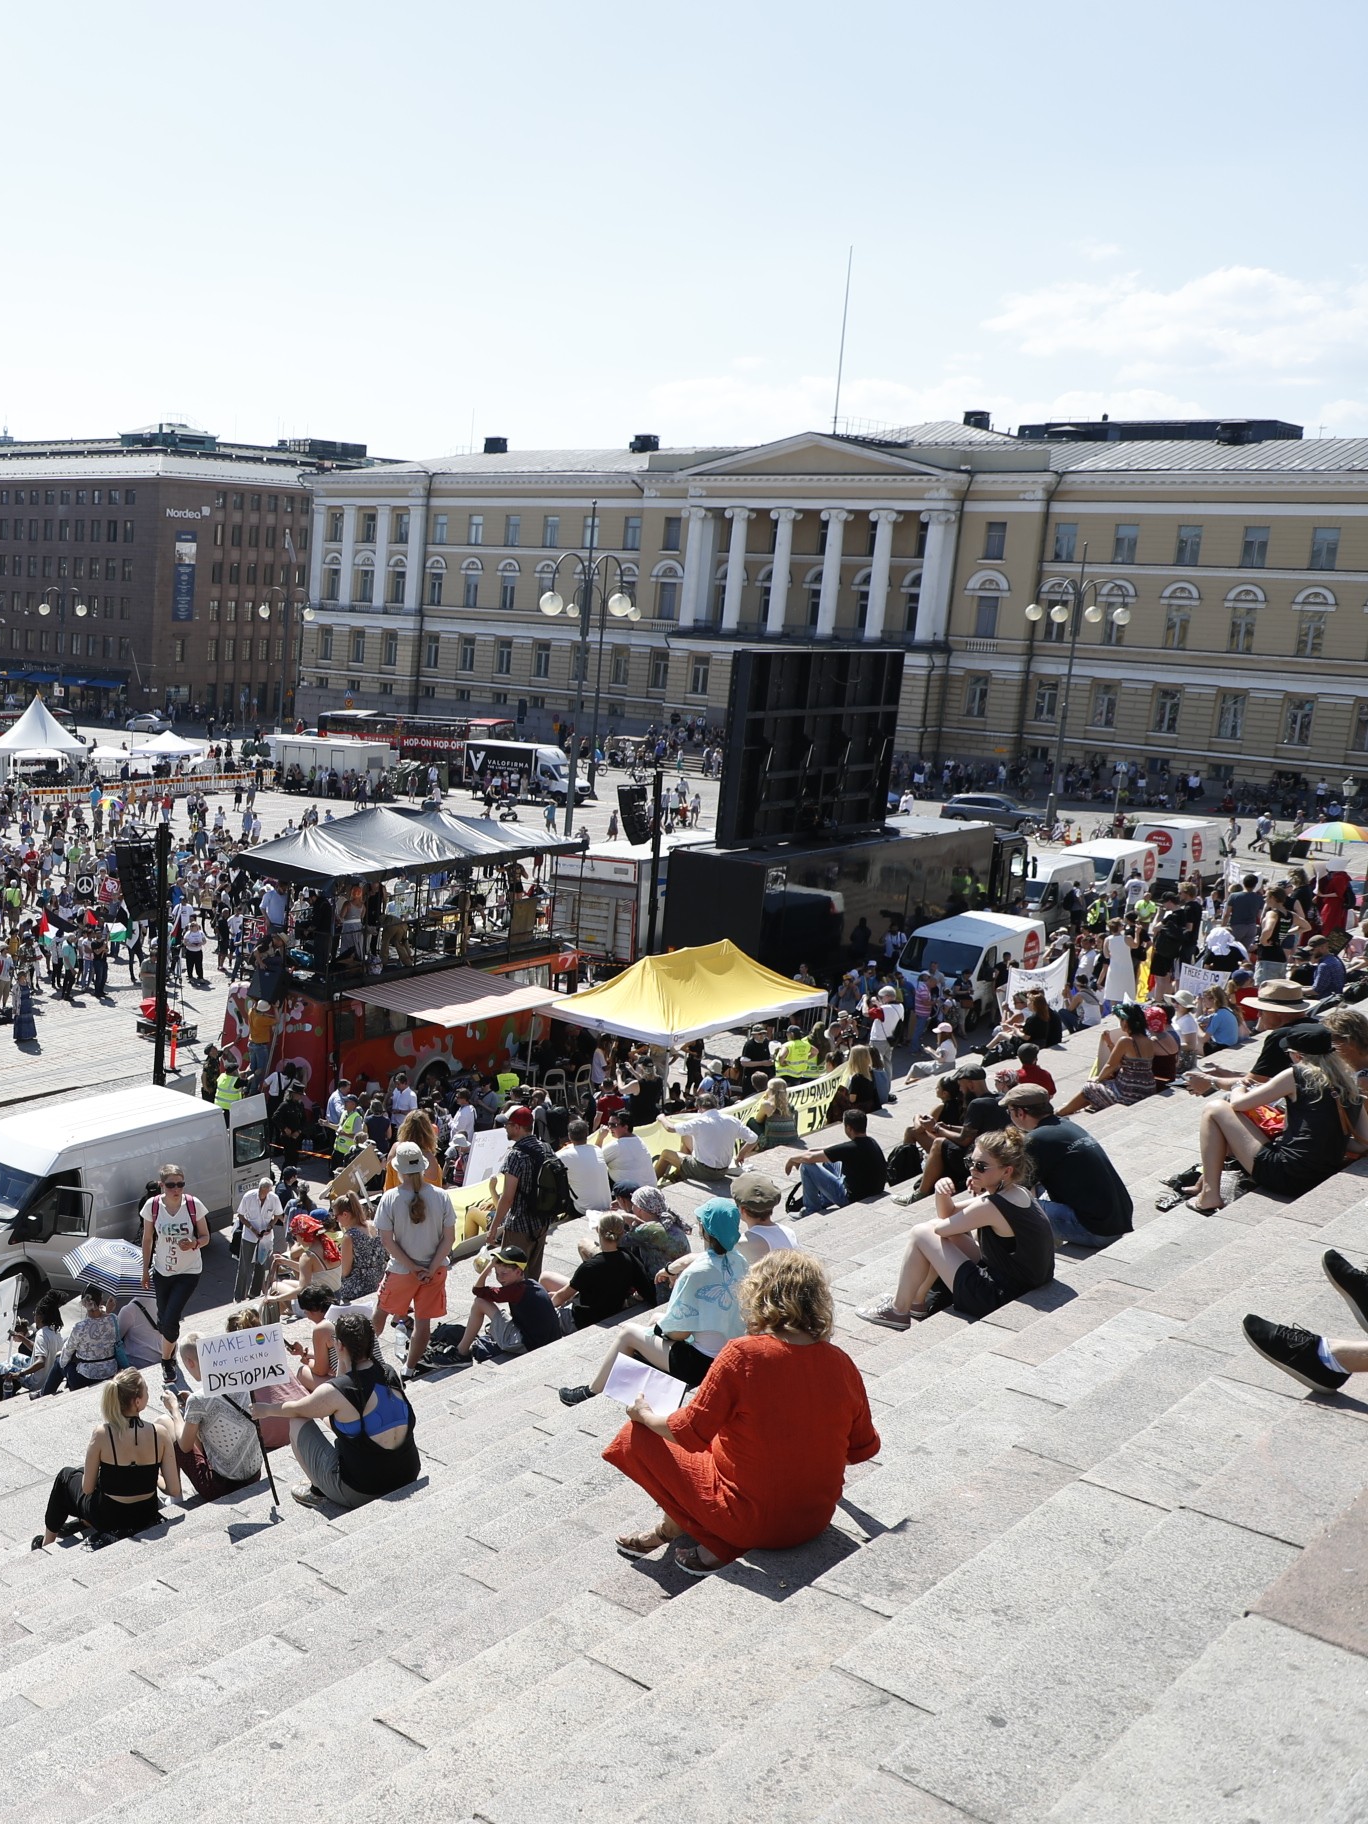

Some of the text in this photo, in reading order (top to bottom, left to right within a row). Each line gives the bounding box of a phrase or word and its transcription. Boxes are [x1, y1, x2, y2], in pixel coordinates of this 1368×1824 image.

[166, 508, 201, 519] Nordea
[403, 738, 432, 747] HOP-ON
[433, 740, 464, 749] HOP-OFF
[487, 760, 529, 768] VALOFIRMA
[201, 1329, 280, 1357] MAKE LOVE
[212, 1351, 269, 1367] NOT FUCKING
[208, 1363, 285, 1391] DYSTOPIAS
